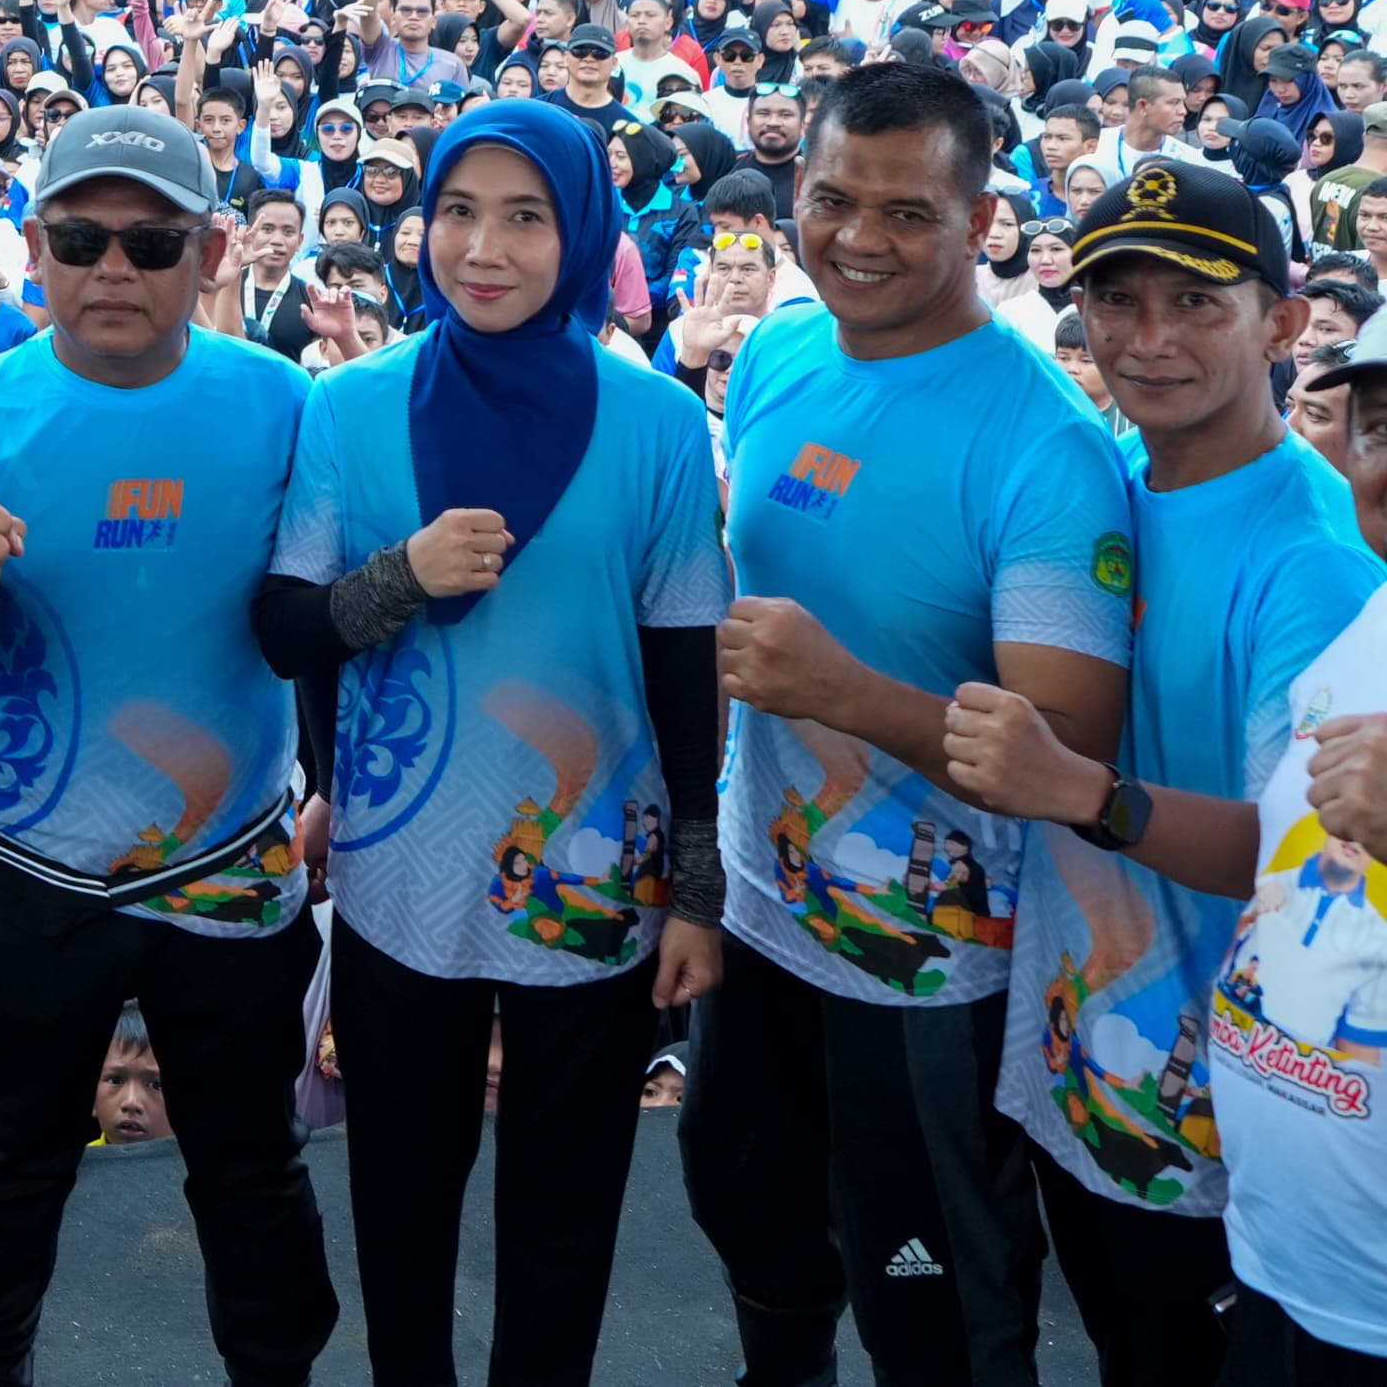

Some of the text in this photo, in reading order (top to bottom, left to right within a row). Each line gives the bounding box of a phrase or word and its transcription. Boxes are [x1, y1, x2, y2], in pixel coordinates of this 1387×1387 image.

[85, 130, 166, 153] XXIO
[789, 440, 862, 497] FUN
[106, 477, 184, 520] FUN
[768, 473, 816, 511] RUN
[94, 519, 145, 549] RUN
[1245, 1025, 1365, 1114] Ketinting
[885, 1260, 944, 1276] adidas
